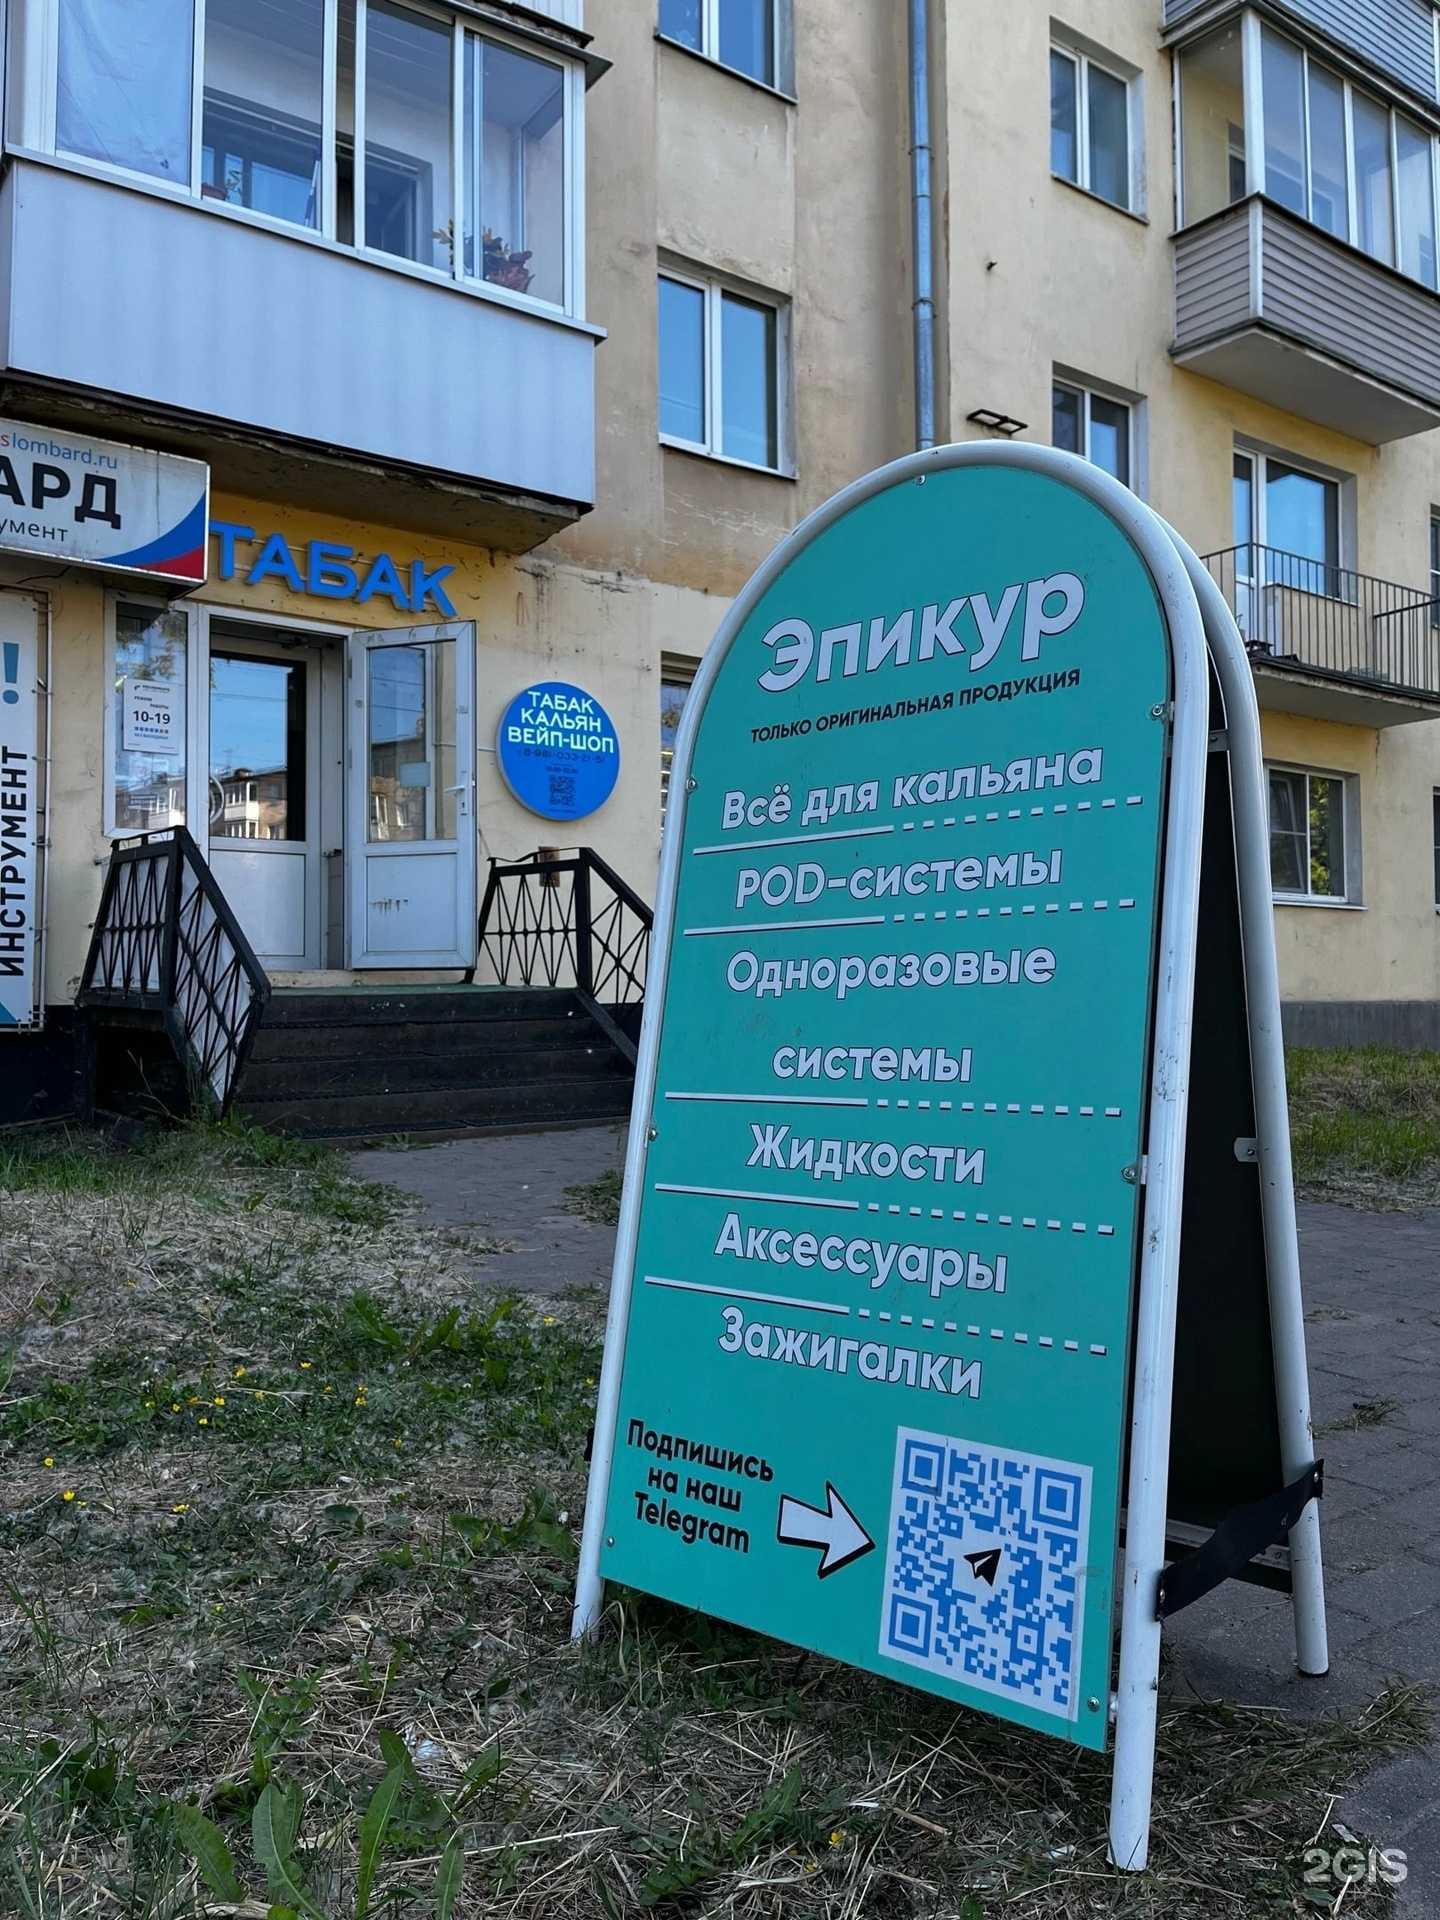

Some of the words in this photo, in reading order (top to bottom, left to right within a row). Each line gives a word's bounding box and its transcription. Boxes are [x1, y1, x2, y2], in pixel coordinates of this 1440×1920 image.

[209, 519, 458, 618] ТАБАК
[757, 571, 1086, 693] Эпикур
[133, 710, 171, 725] 10-19
[521, 708, 602, 733] КАЛЬЯН
[528, 691, 595, 715] ТАБАК
[751, 719, 812, 744] ТОЛЬКО
[816, 693, 954, 732] ОРИГИНАЛЬНАЯ
[959, 669, 1081, 706] ПРОДУКЦИЯ
[508, 726, 614, 754] ВЕЙП-ШОП
[721, 783, 791, 830] Всё
[800, 780, 879, 827] для
[892, 747, 1104, 809] кальяна
[0, 746, 27, 977] ИНСТРУМЕНТ
[735, 849, 1063, 909] POD-системы
[726, 946, 1057, 999] Одноразовые
[772, 1045, 973, 1082] системы
[745, 1123, 986, 1185] Жидкости
[714, 1212, 1008, 1298] Аксессуары
[718, 1306, 983, 1399] Зажигалки
[627, 1418, 775, 1482] Подпишись
[648, 1465, 678, 1494] на
[686, 1474, 742, 1512] наш
[634, 1491, 750, 1553] Telegram
